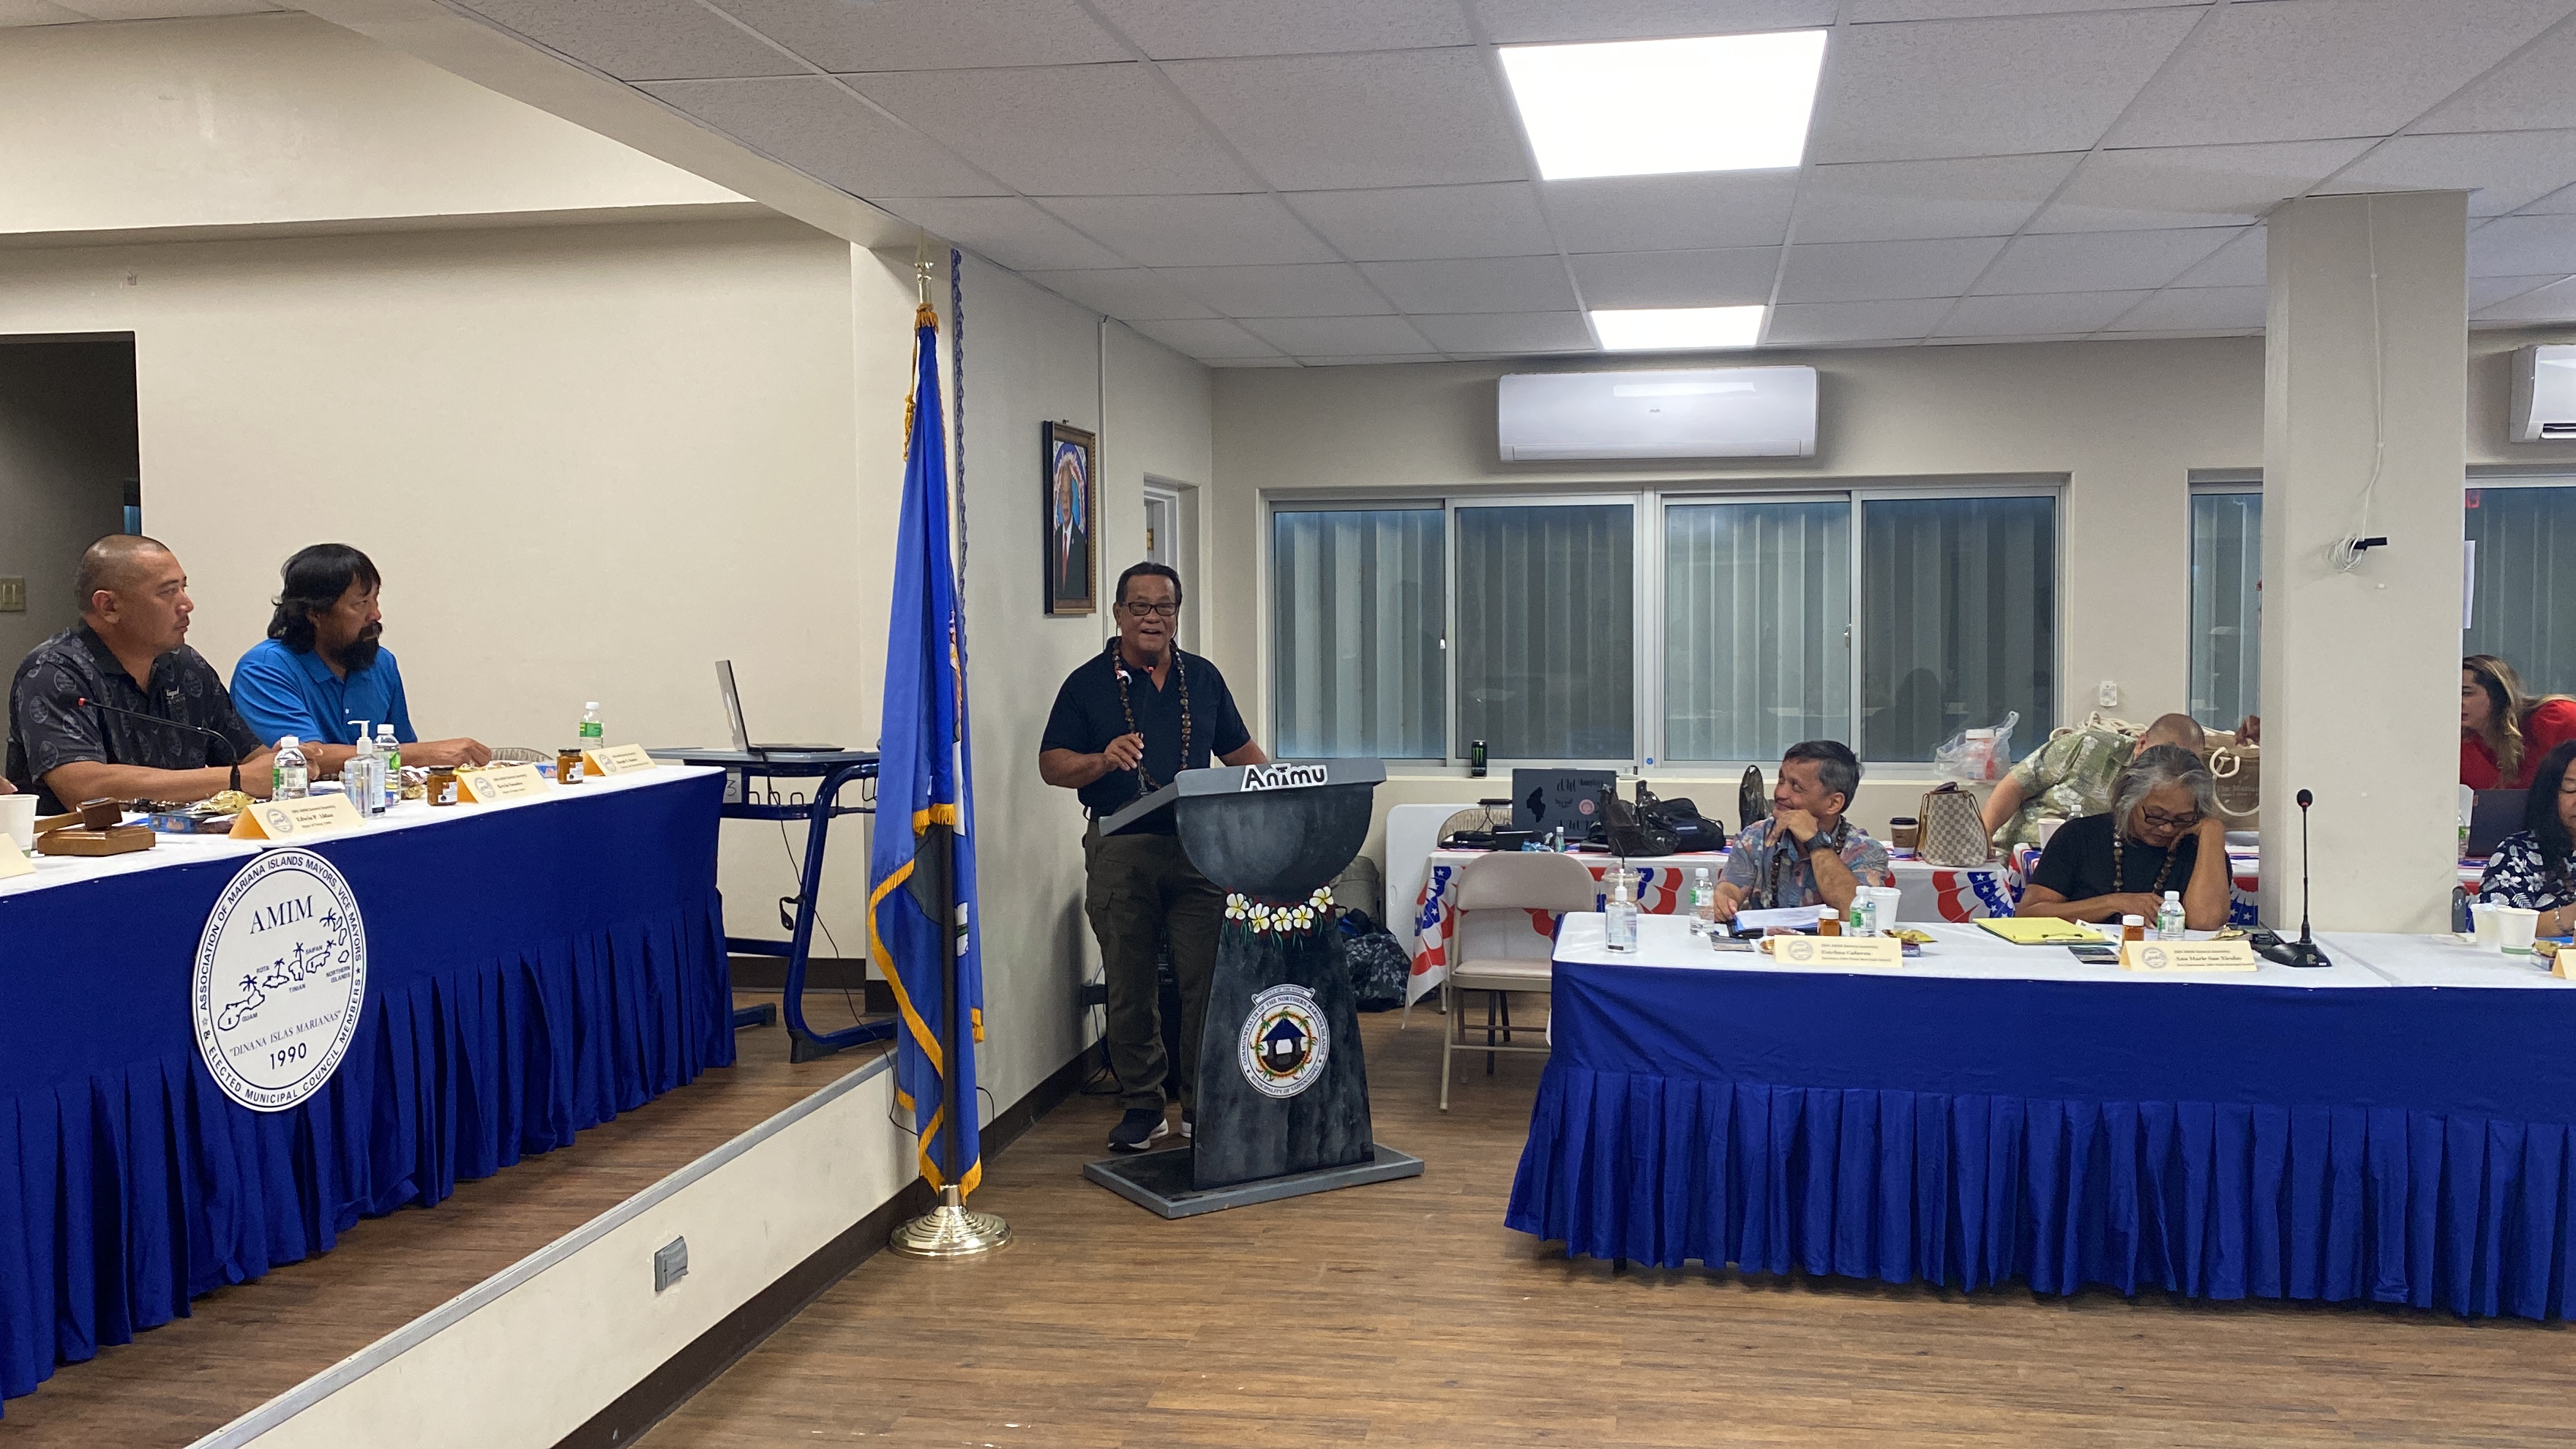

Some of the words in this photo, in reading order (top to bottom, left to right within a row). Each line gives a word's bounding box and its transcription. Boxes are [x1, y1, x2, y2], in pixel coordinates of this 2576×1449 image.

[1243, 765, 1326, 790] Animu
[250, 895, 314, 935] AMIM
[199, 925, 220, 1010] ASSOCIATION
[217, 906, 228, 921] OF
[228, 865, 266, 905] MARIANA
[268, 855, 304, 870] ISLANDS
[337, 886, 351, 911] VICE
[348, 912, 362, 962] MAYORS
[306, 946, 323, 955] SAIPAN
[256, 965, 270, 974] ROTA
[326, 965, 350, 977] NORTHERN
[331, 972, 351, 983] ISLANDS
[289, 984, 306, 993] TINIAN
[242, 1012, 258, 1022] GUAM
[270, 1027, 293, 1044] ISLAS
[1241, 1011, 1259, 1066] COMMONWEALTH
[1258, 1005, 1265, 1013] OF
[1265, 998, 1277, 1007] THE
[1278, 996, 1308, 1007] NORTHERN
[1307, 1004, 1323, 1028] MARIANA
[203, 1030, 211, 1041] &
[209, 1046, 242, 1093] ELECTED
[244, 1088, 298, 1104] MUNICIPAL
[302, 1049, 340, 1092] COUNCIL
[339, 978, 362, 1044] MEMBERS
[269, 1042, 307, 1070] 1990
[1251, 1074, 1283, 1094] MUNICIPALITY
